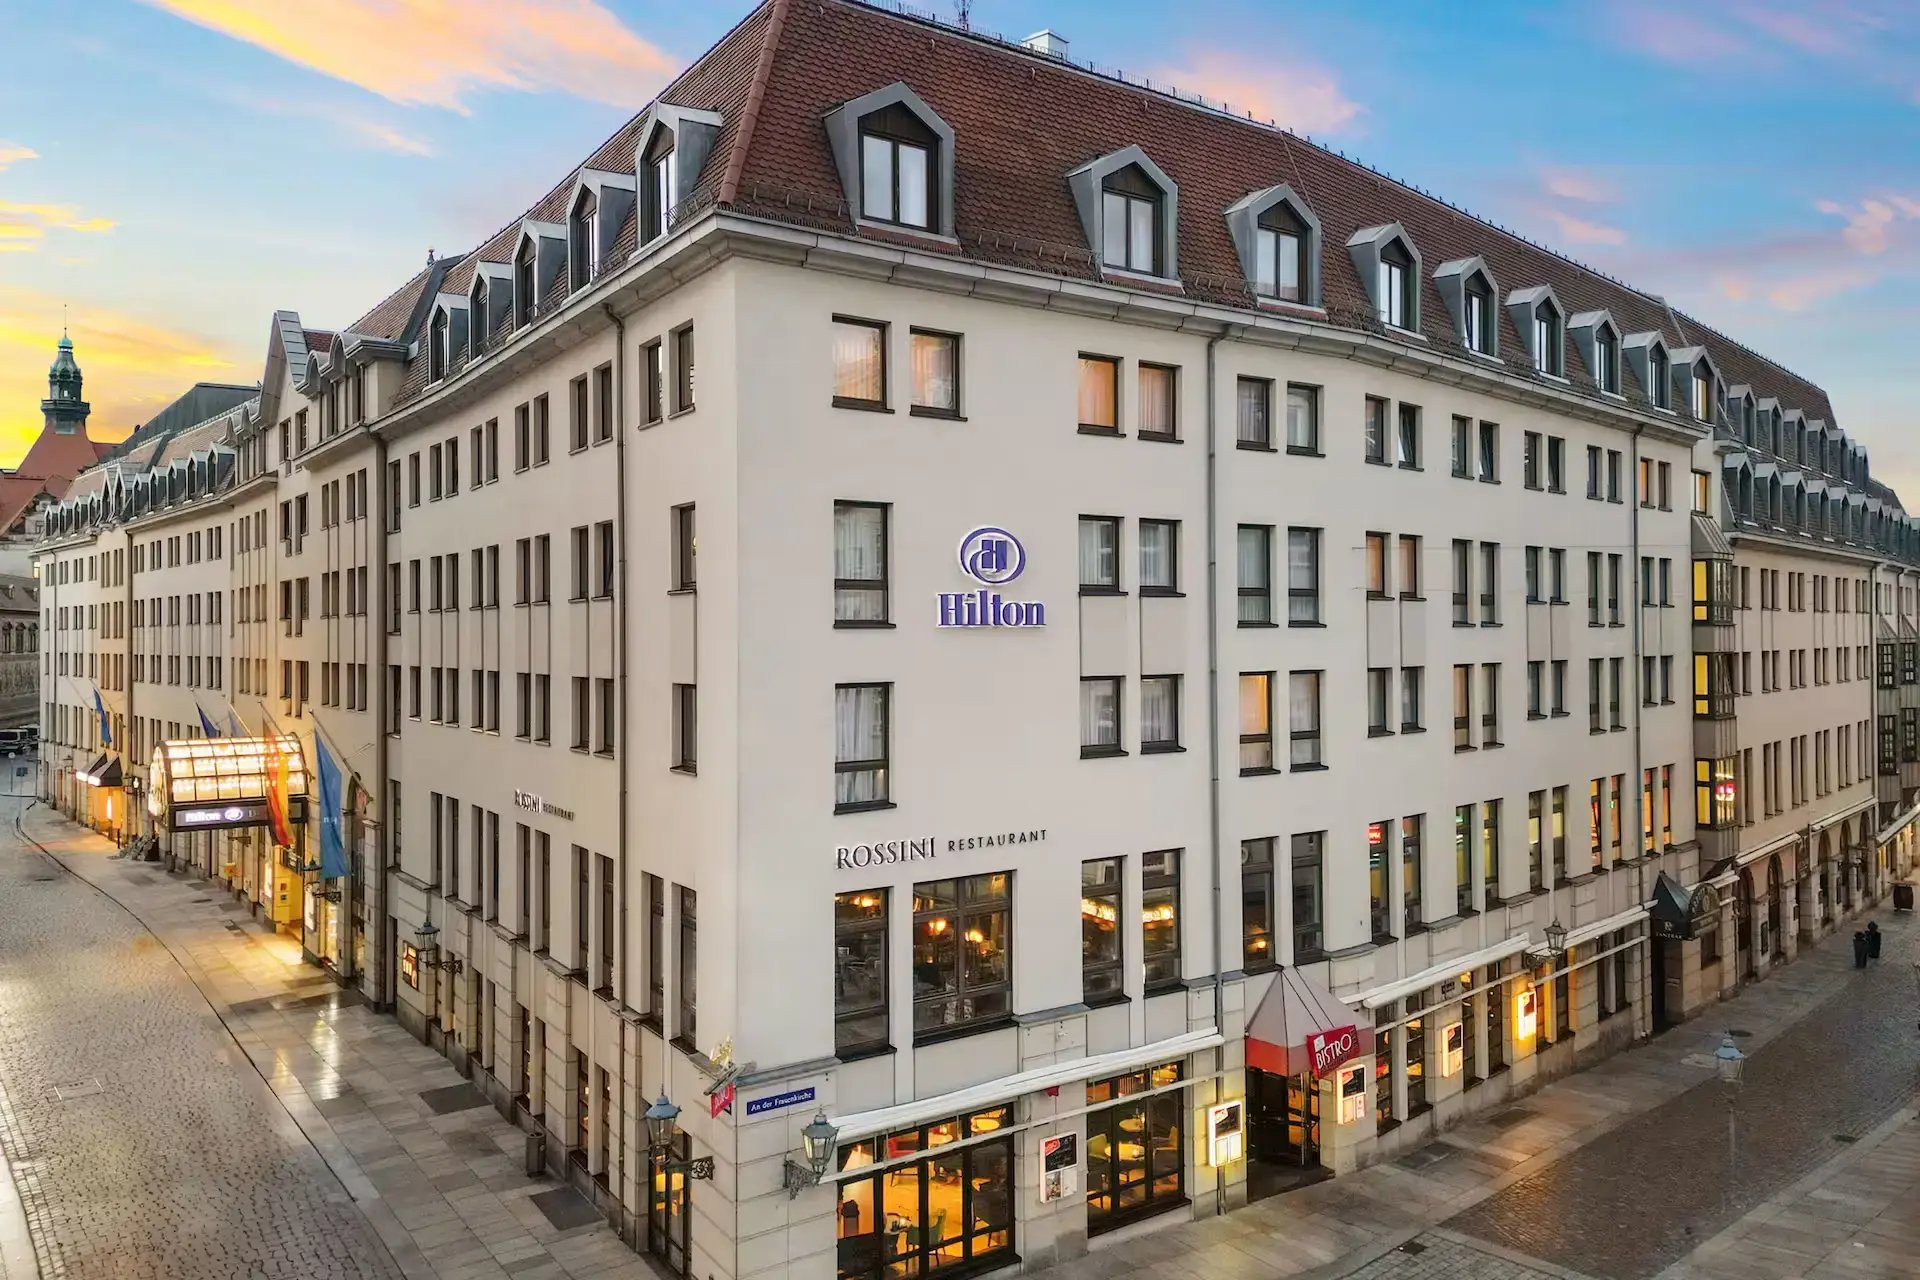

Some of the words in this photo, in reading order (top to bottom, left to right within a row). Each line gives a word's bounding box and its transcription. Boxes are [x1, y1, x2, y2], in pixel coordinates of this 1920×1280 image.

[937, 589, 1047, 628] Hilton
[514, 789, 542, 814] ROSSINI
[542, 802, 575, 821] RESTAURANT
[836, 836, 936, 870] ROSSINI
[948, 829, 1048, 852] RESTAURANT
[1315, 1033, 1352, 1070] BISTRO
[750, 1104, 761, 1112] An
[762, 1101, 773, 1109] der
[774, 1092, 812, 1107] Frauenkirche
